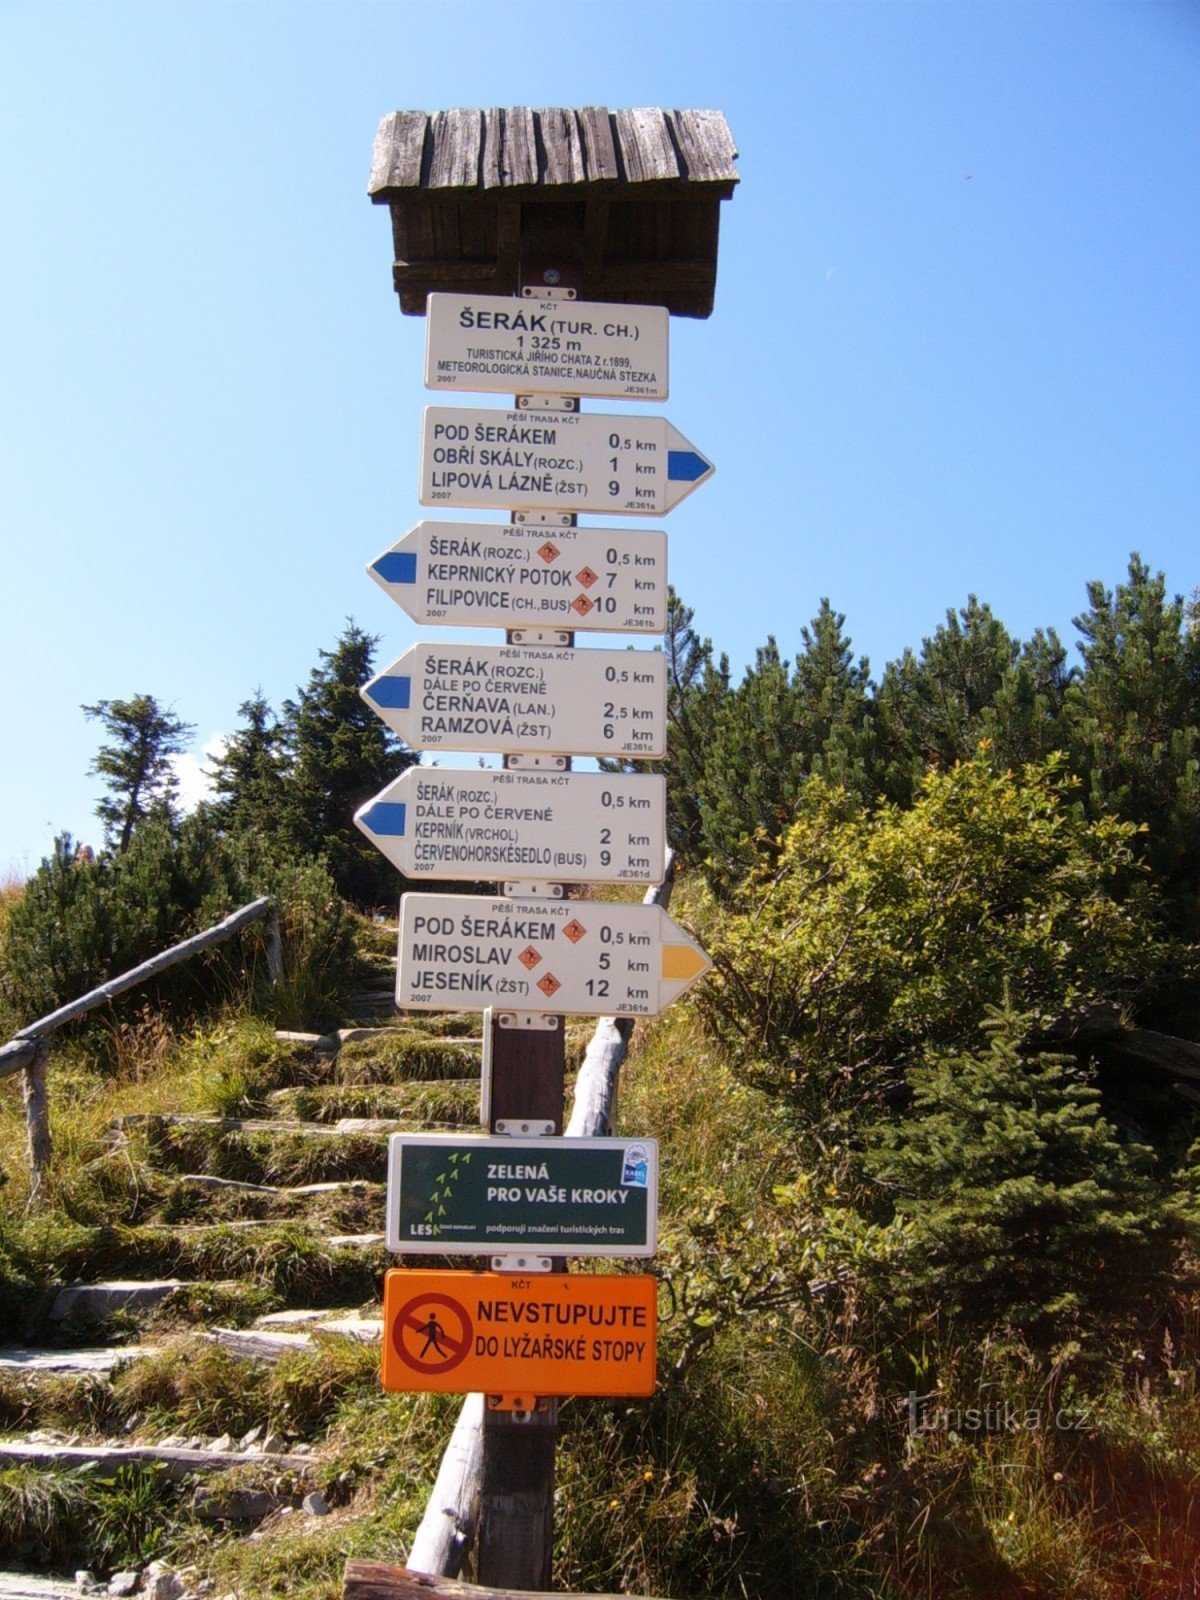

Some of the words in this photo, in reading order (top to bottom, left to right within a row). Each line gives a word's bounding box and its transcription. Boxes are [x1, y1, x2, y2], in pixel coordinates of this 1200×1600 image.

[460, 307, 546, 332] ŠERÁK
[603, 323, 639, 341] CH.)
[531, 336, 561, 349] 325
[567, 341, 581, 350] m
[467, 347, 523, 360] TURISTICKÁ
[527, 350, 558, 363] JIŘÍHO
[561, 353, 592, 365] CHATA
[437, 375, 456, 383] 2007
[438, 360, 529, 375] METEOROLOGICKÁ
[619, 371, 656, 382] STEZKA
[507, 412, 527, 421] PĚŠÍ
[530, 415, 559, 423] TRASA
[562, 415, 580, 424] KČT
[435, 424, 469, 441] POD
[475, 423, 556, 445] ŠERÁKEM
[636, 440, 656, 451] km
[433, 445, 474, 464] OBŘÍ
[609, 458, 618, 472] 1
[636, 464, 656, 475] km
[432, 469, 493, 490] LIPOVÁ
[608, 481, 619, 495] 9
[636, 487, 655, 498] km
[503, 527, 523, 537] PĚŠÍ
[527, 530, 556, 538] TRASA
[559, 530, 578, 539] KČT
[635, 555, 655, 566] km
[428, 564, 516, 584] KEPRNICKÝ
[520, 569, 572, 586] POTOK
[606, 573, 617, 588] 7
[634, 579, 655, 590] km
[595, 597, 617, 612] 10
[634, 604, 655, 615] km
[500, 650, 520, 658] PĚŠÍ
[523, 652, 554, 660] TRASA
[556, 651, 575, 661] KČT
[424, 677, 458, 691] DÁLE
[463, 681, 480, 692] PO
[484, 677, 547, 695] ČERVENÉ
[633, 672, 654, 683] km
[632, 708, 653, 720] km
[422, 735, 442, 743] 2007
[604, 724, 614, 739] 6
[632, 729, 653, 741] km
[493, 775, 514, 784] PĚŠÍ
[517, 777, 548, 785] TRASA
[551, 777, 570, 786] KČT
[629, 797, 650, 808] km
[416, 802, 455, 819] DÁLE
[459, 807, 479, 819] PO
[484, 805, 553, 821] ČERVENÉ
[600, 829, 611, 844] 2
[628, 834, 649, 845] km
[414, 863, 435, 871] 2007
[600, 851, 611, 866] 9
[628, 856, 649, 868] km
[492, 903, 513, 913] PĚŠÍ
[516, 906, 548, 915] TRASA
[550, 906, 569, 916] KČT
[414, 917, 454, 936] POD
[461, 915, 555, 940] ŠERÁKEM
[629, 933, 650, 945] km
[412, 944, 512, 965] MIROSLAV
[599, 953, 611, 970] 5
[628, 960, 649, 972] km
[411, 994, 432, 1002] 2007
[585, 980, 609, 997] 12
[627, 987, 648, 999] km
[487, 1162, 549, 1180] ZELENÁ
[487, 1187, 521, 1202] PRO
[525, 1185, 567, 1204] VAŠE
[571, 1189, 629, 1204] KROKY
[528, 1225, 558, 1233] značení
[560, 1225, 607, 1235] turistických
[609, 1226, 625, 1234] tras
[512, 1280, 531, 1289] KČT
[478, 1301, 646, 1327] NEVSTUPUJTE
[475, 1336, 498, 1357] DO
[504, 1332, 586, 1360] LYŽAŘSKÉ
[592, 1341, 645, 1362] STOPY
